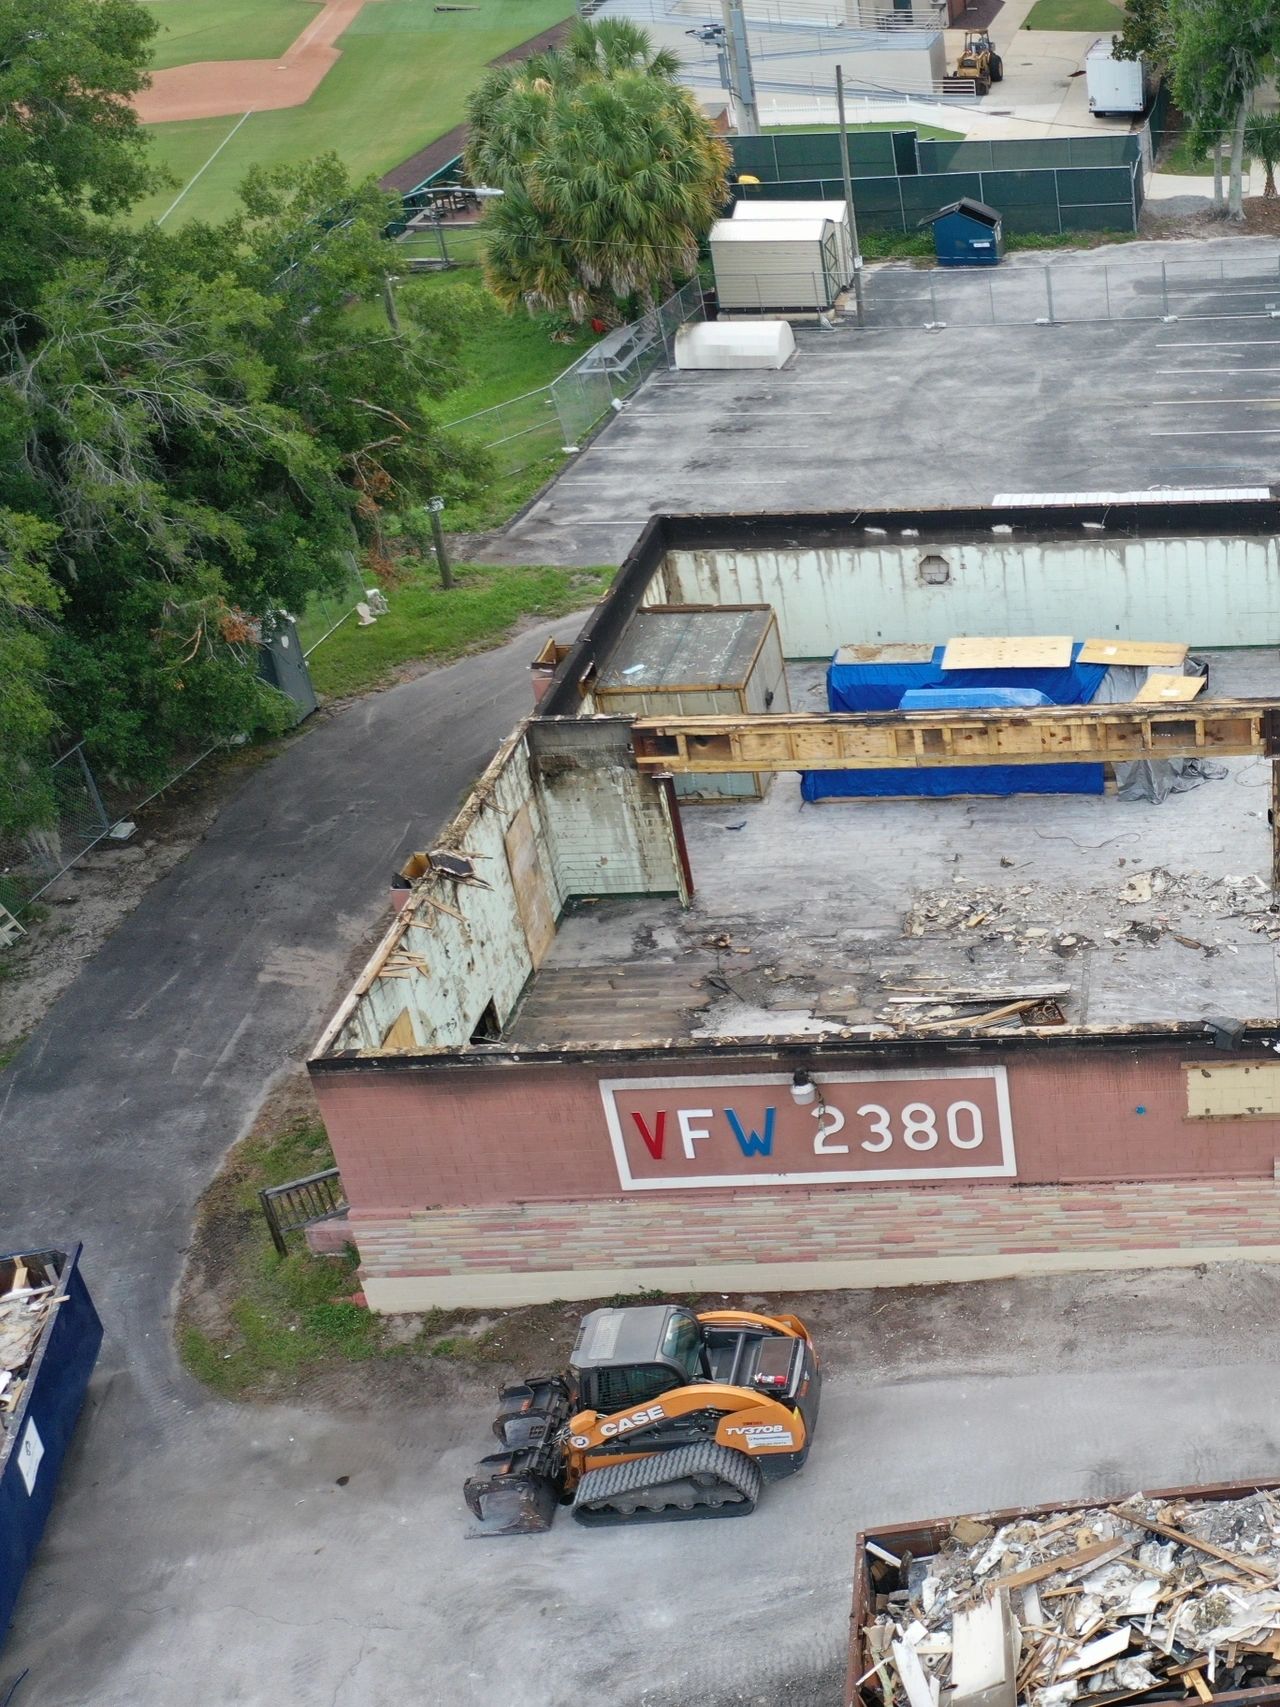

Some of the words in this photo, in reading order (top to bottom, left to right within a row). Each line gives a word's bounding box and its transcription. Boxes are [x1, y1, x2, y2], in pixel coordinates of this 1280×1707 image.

[631, 1106, 776, 1161] VFW
[810, 1100, 984, 1155] 2380
[600, 1405, 665, 1437] CASE
[725, 1424, 784, 1436] TV370B
